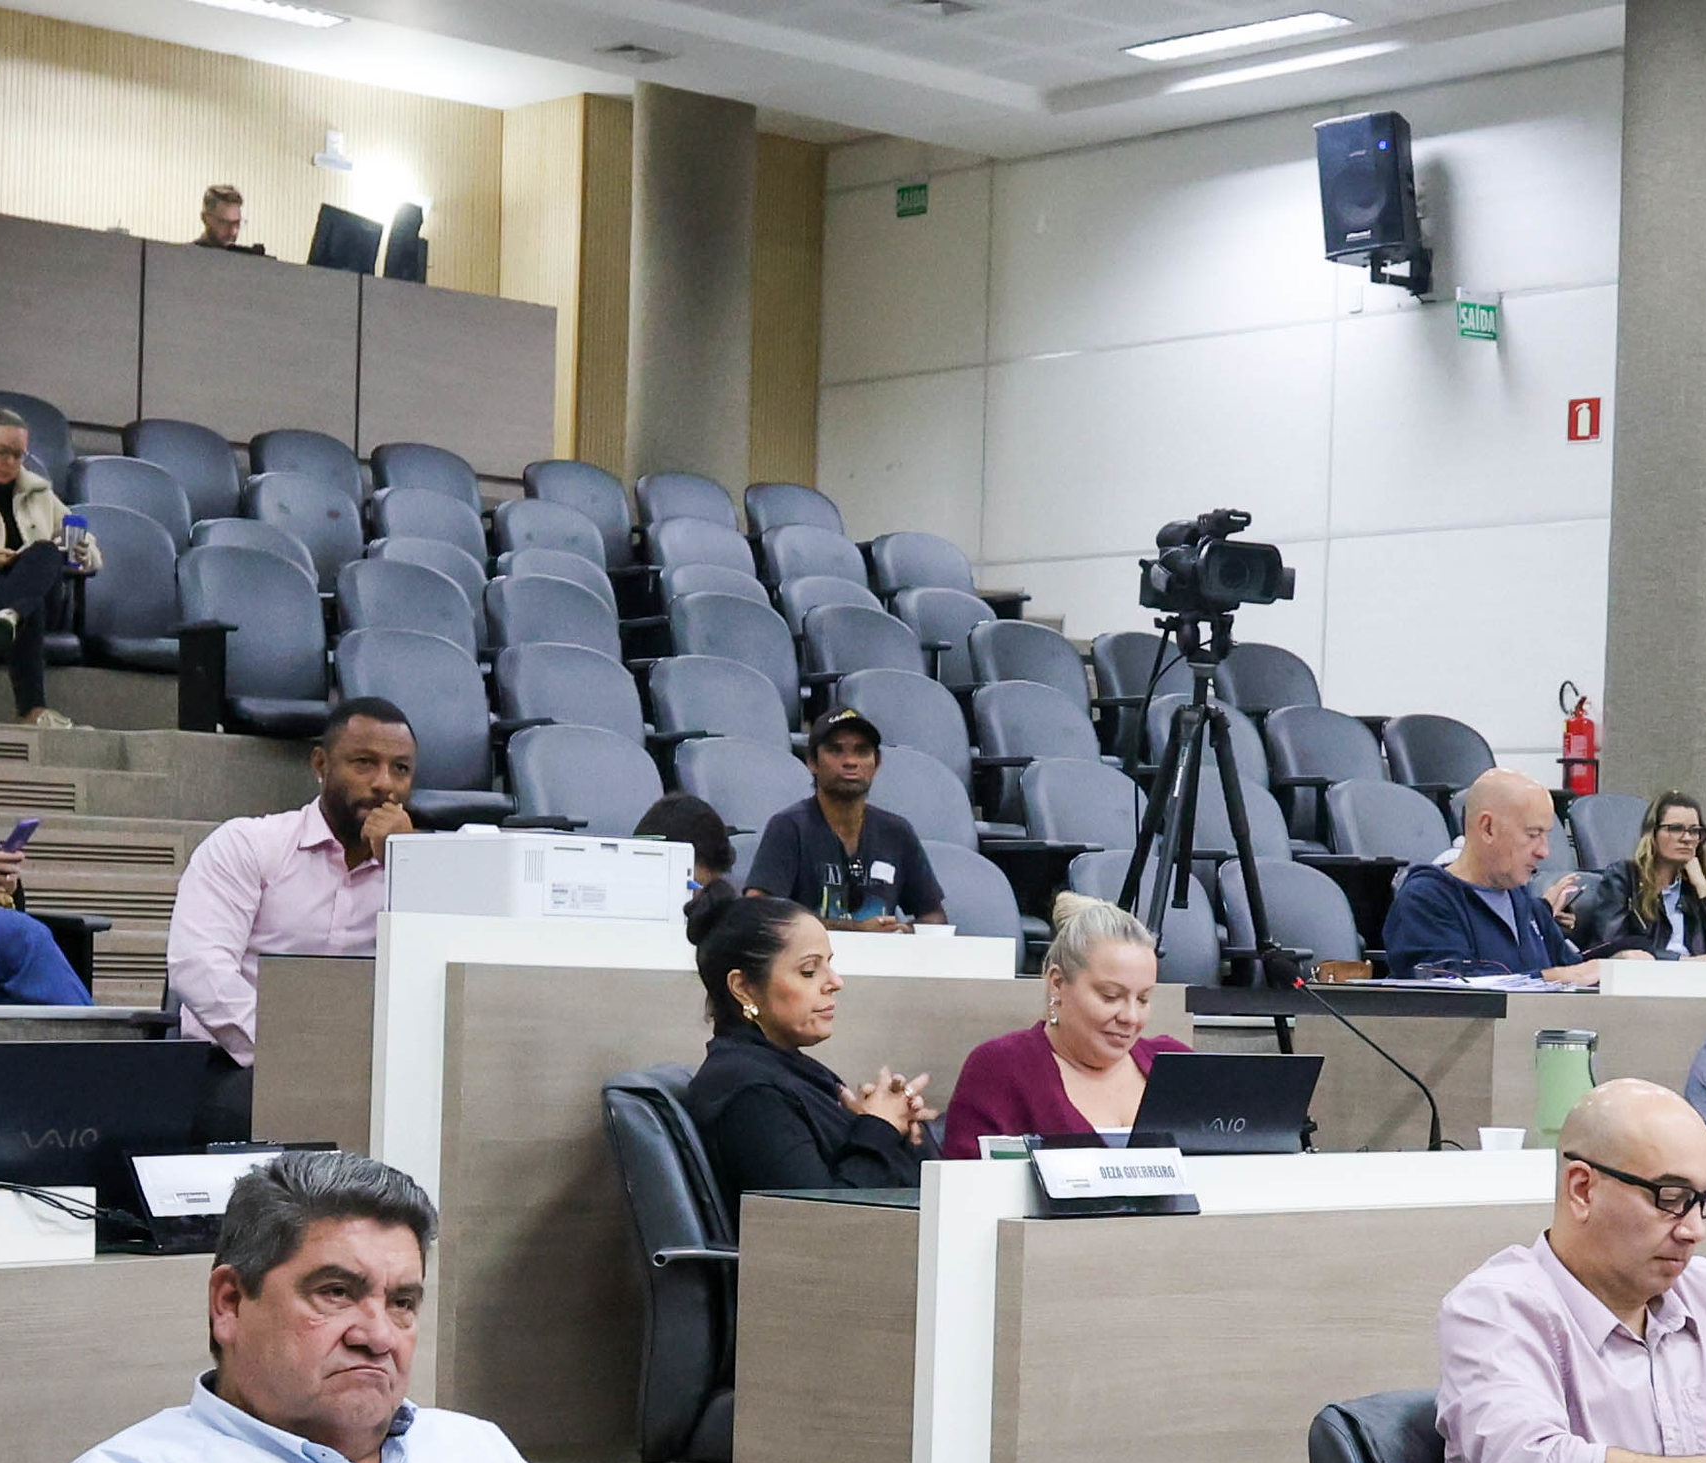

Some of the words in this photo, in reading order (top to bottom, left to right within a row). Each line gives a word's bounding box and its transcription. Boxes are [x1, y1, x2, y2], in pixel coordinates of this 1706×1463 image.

[1460, 304, 1496, 333] SAÍDA
[22, 1127, 99, 1150] VAIO
[1099, 1165, 1124, 1180] DEZA
[1124, 1164, 1175, 1179] GUERREIRO
